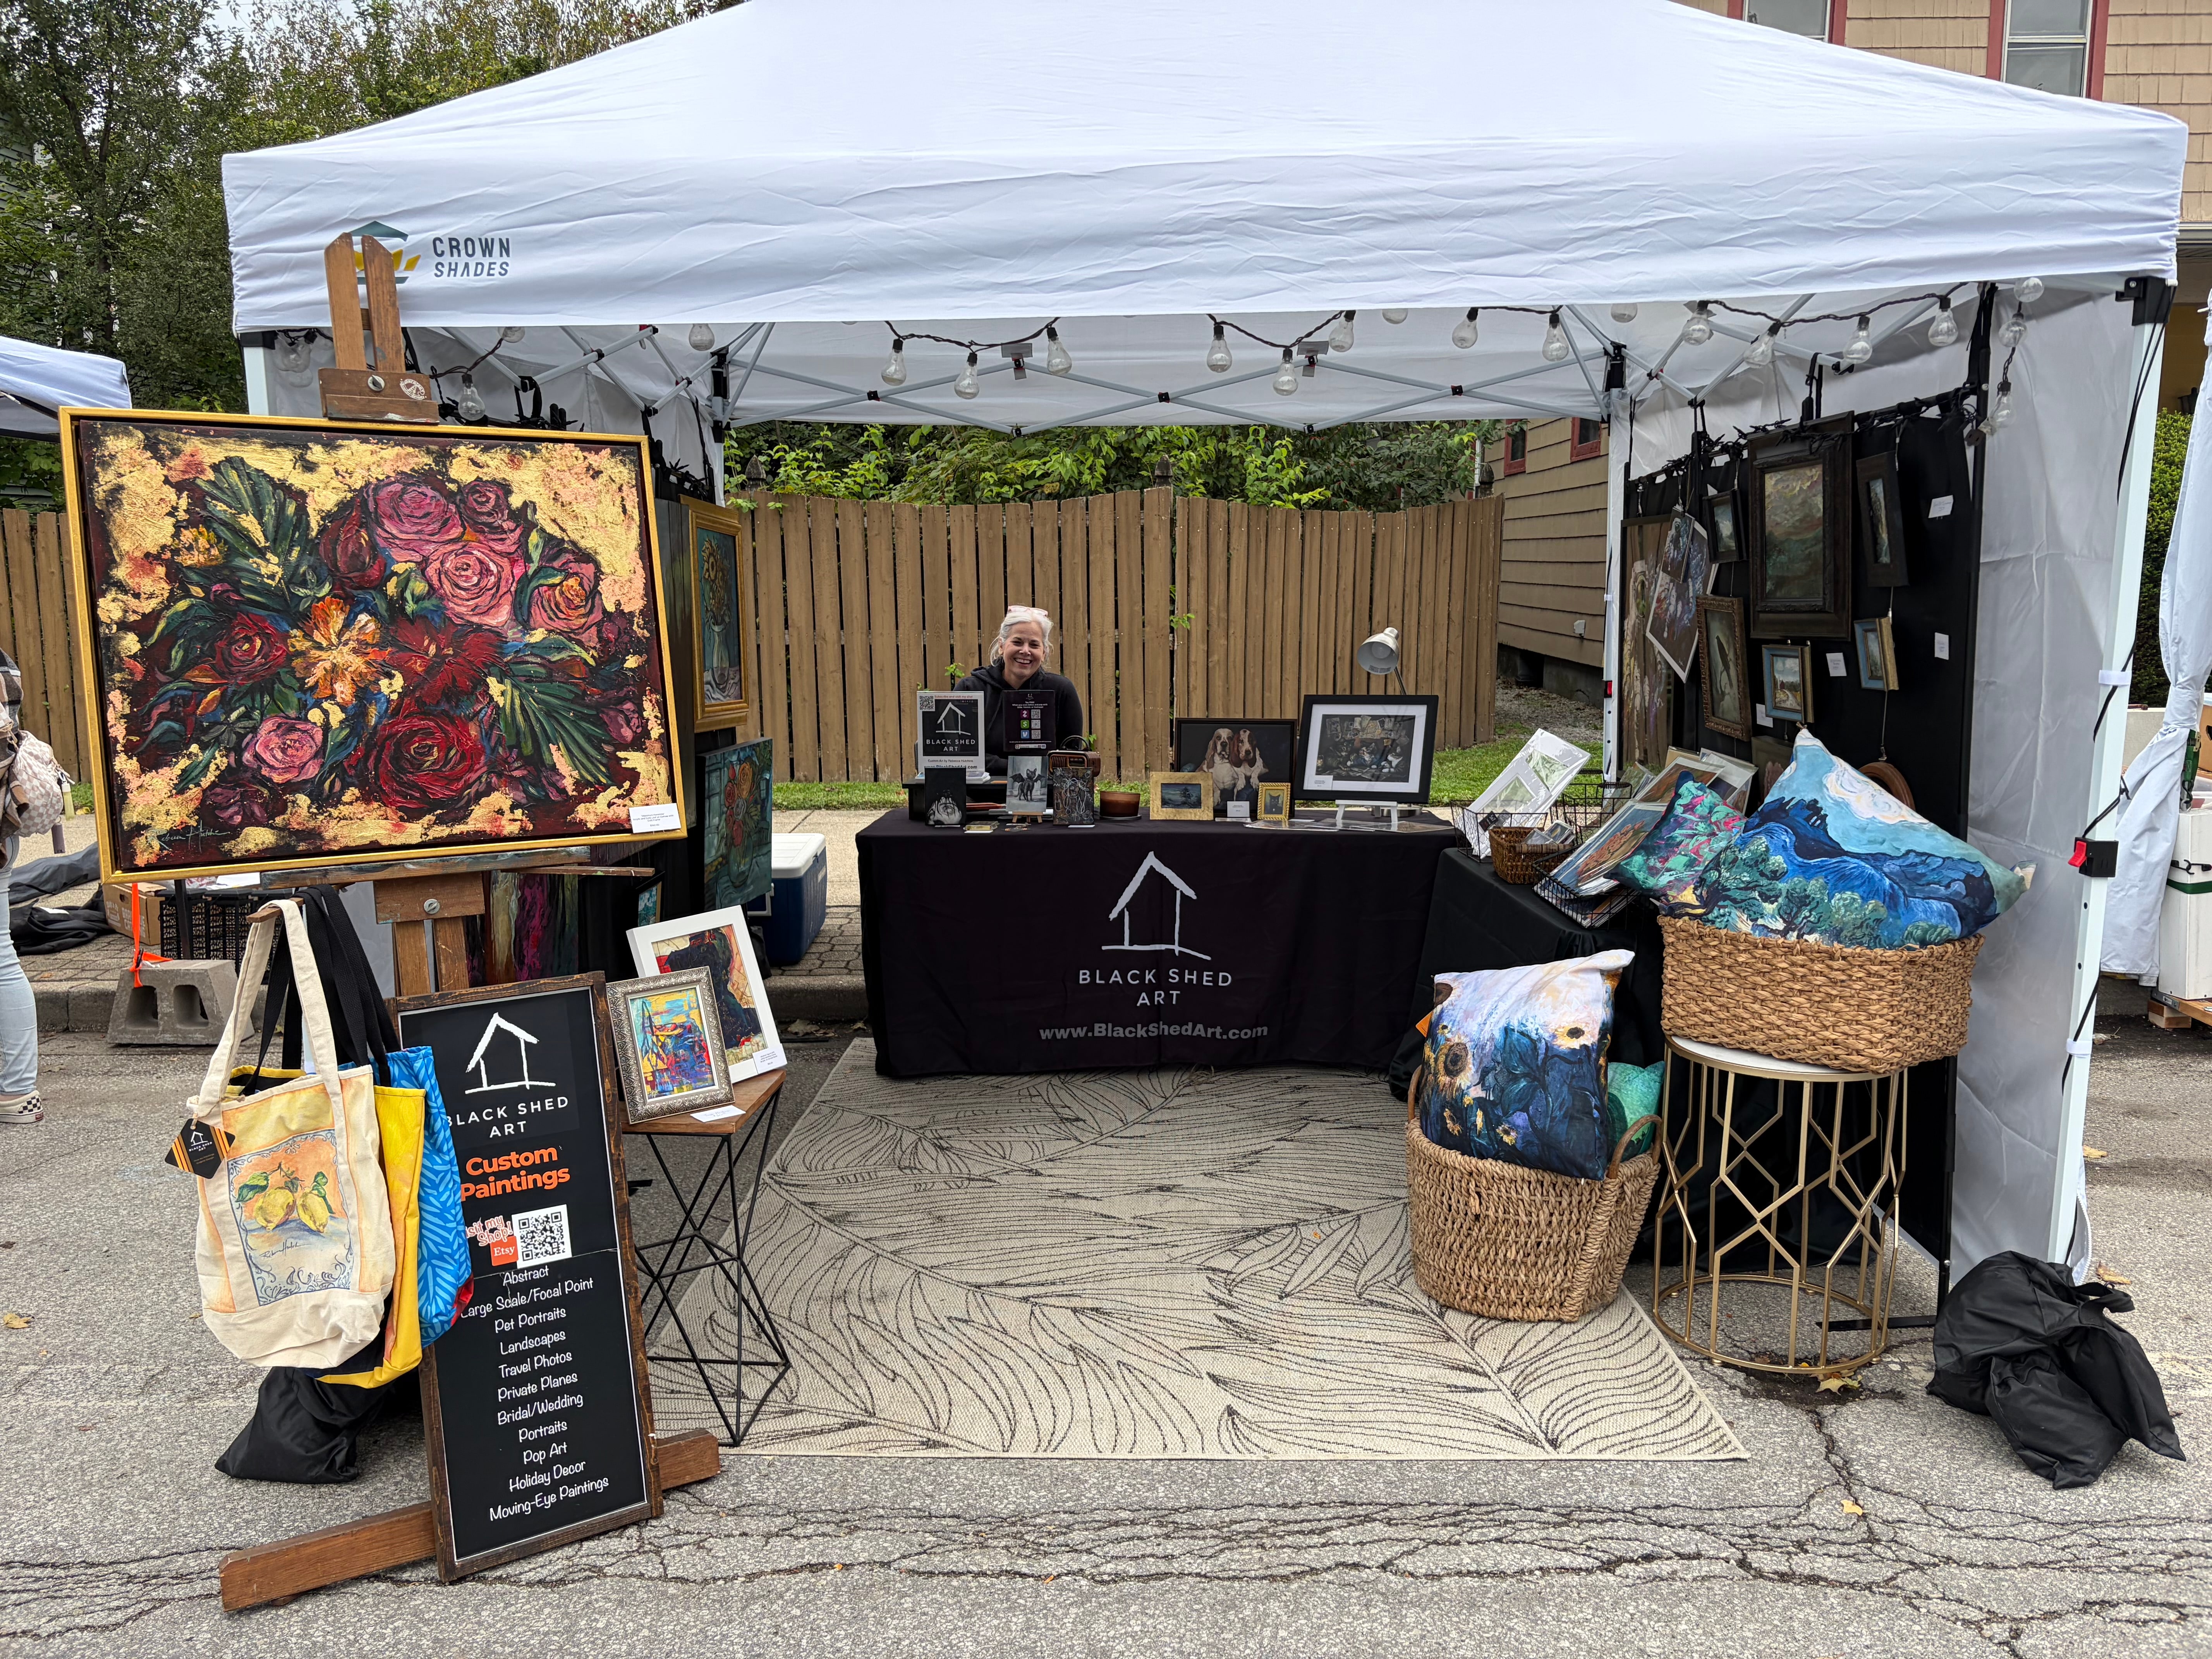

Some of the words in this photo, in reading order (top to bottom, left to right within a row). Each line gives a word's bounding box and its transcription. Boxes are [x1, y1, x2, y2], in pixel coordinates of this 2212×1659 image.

[433, 237, 510, 258] CROWN
[434, 262, 508, 277] SHADES
[1080, 970, 1155, 984] BLACK
[1169, 969, 1231, 986] SHED
[1137, 991, 1180, 1006] ART
[1040, 1022, 1267, 1039] www.BlackShedArt.com
[518, 1097, 568, 1114] SHED
[490, 1121, 526, 1137] ART
[466, 1147, 557, 1175] Custom
[461, 1169, 570, 1201] Paintings
[485, 1215, 505, 1230] my
[477, 1221, 514, 1247] Shop!
[493, 1246, 515, 1257] Etsy
[503, 1266, 549, 1286] Abstract
[496, 1283, 562, 1309] Scale/Focal
[565, 1278, 593, 1294] Point
[495, 1319, 514, 1333] Pet
[519, 1308, 566, 1328] Portraits
[500, 1331, 565, 1354] Landscapes
[499, 1358, 531, 1377] Travel
[534, 1352, 572, 1369] Photos
[498, 1383, 537, 1401] Private
[541, 1374, 577, 1390] Planes
[498, 1394, 583, 1425] Bridal/Wedding
[519, 1421, 567, 1442] Portraits
[524, 1450, 546, 1464] Pop
[550, 1442, 567, 1457] Art
[510, 1472, 550, 1492] Holiday
[553, 1462, 586, 1479] Decor
[490, 1493, 556, 1521] Moving-Eye
[560, 1478, 609, 1499] Paintings
